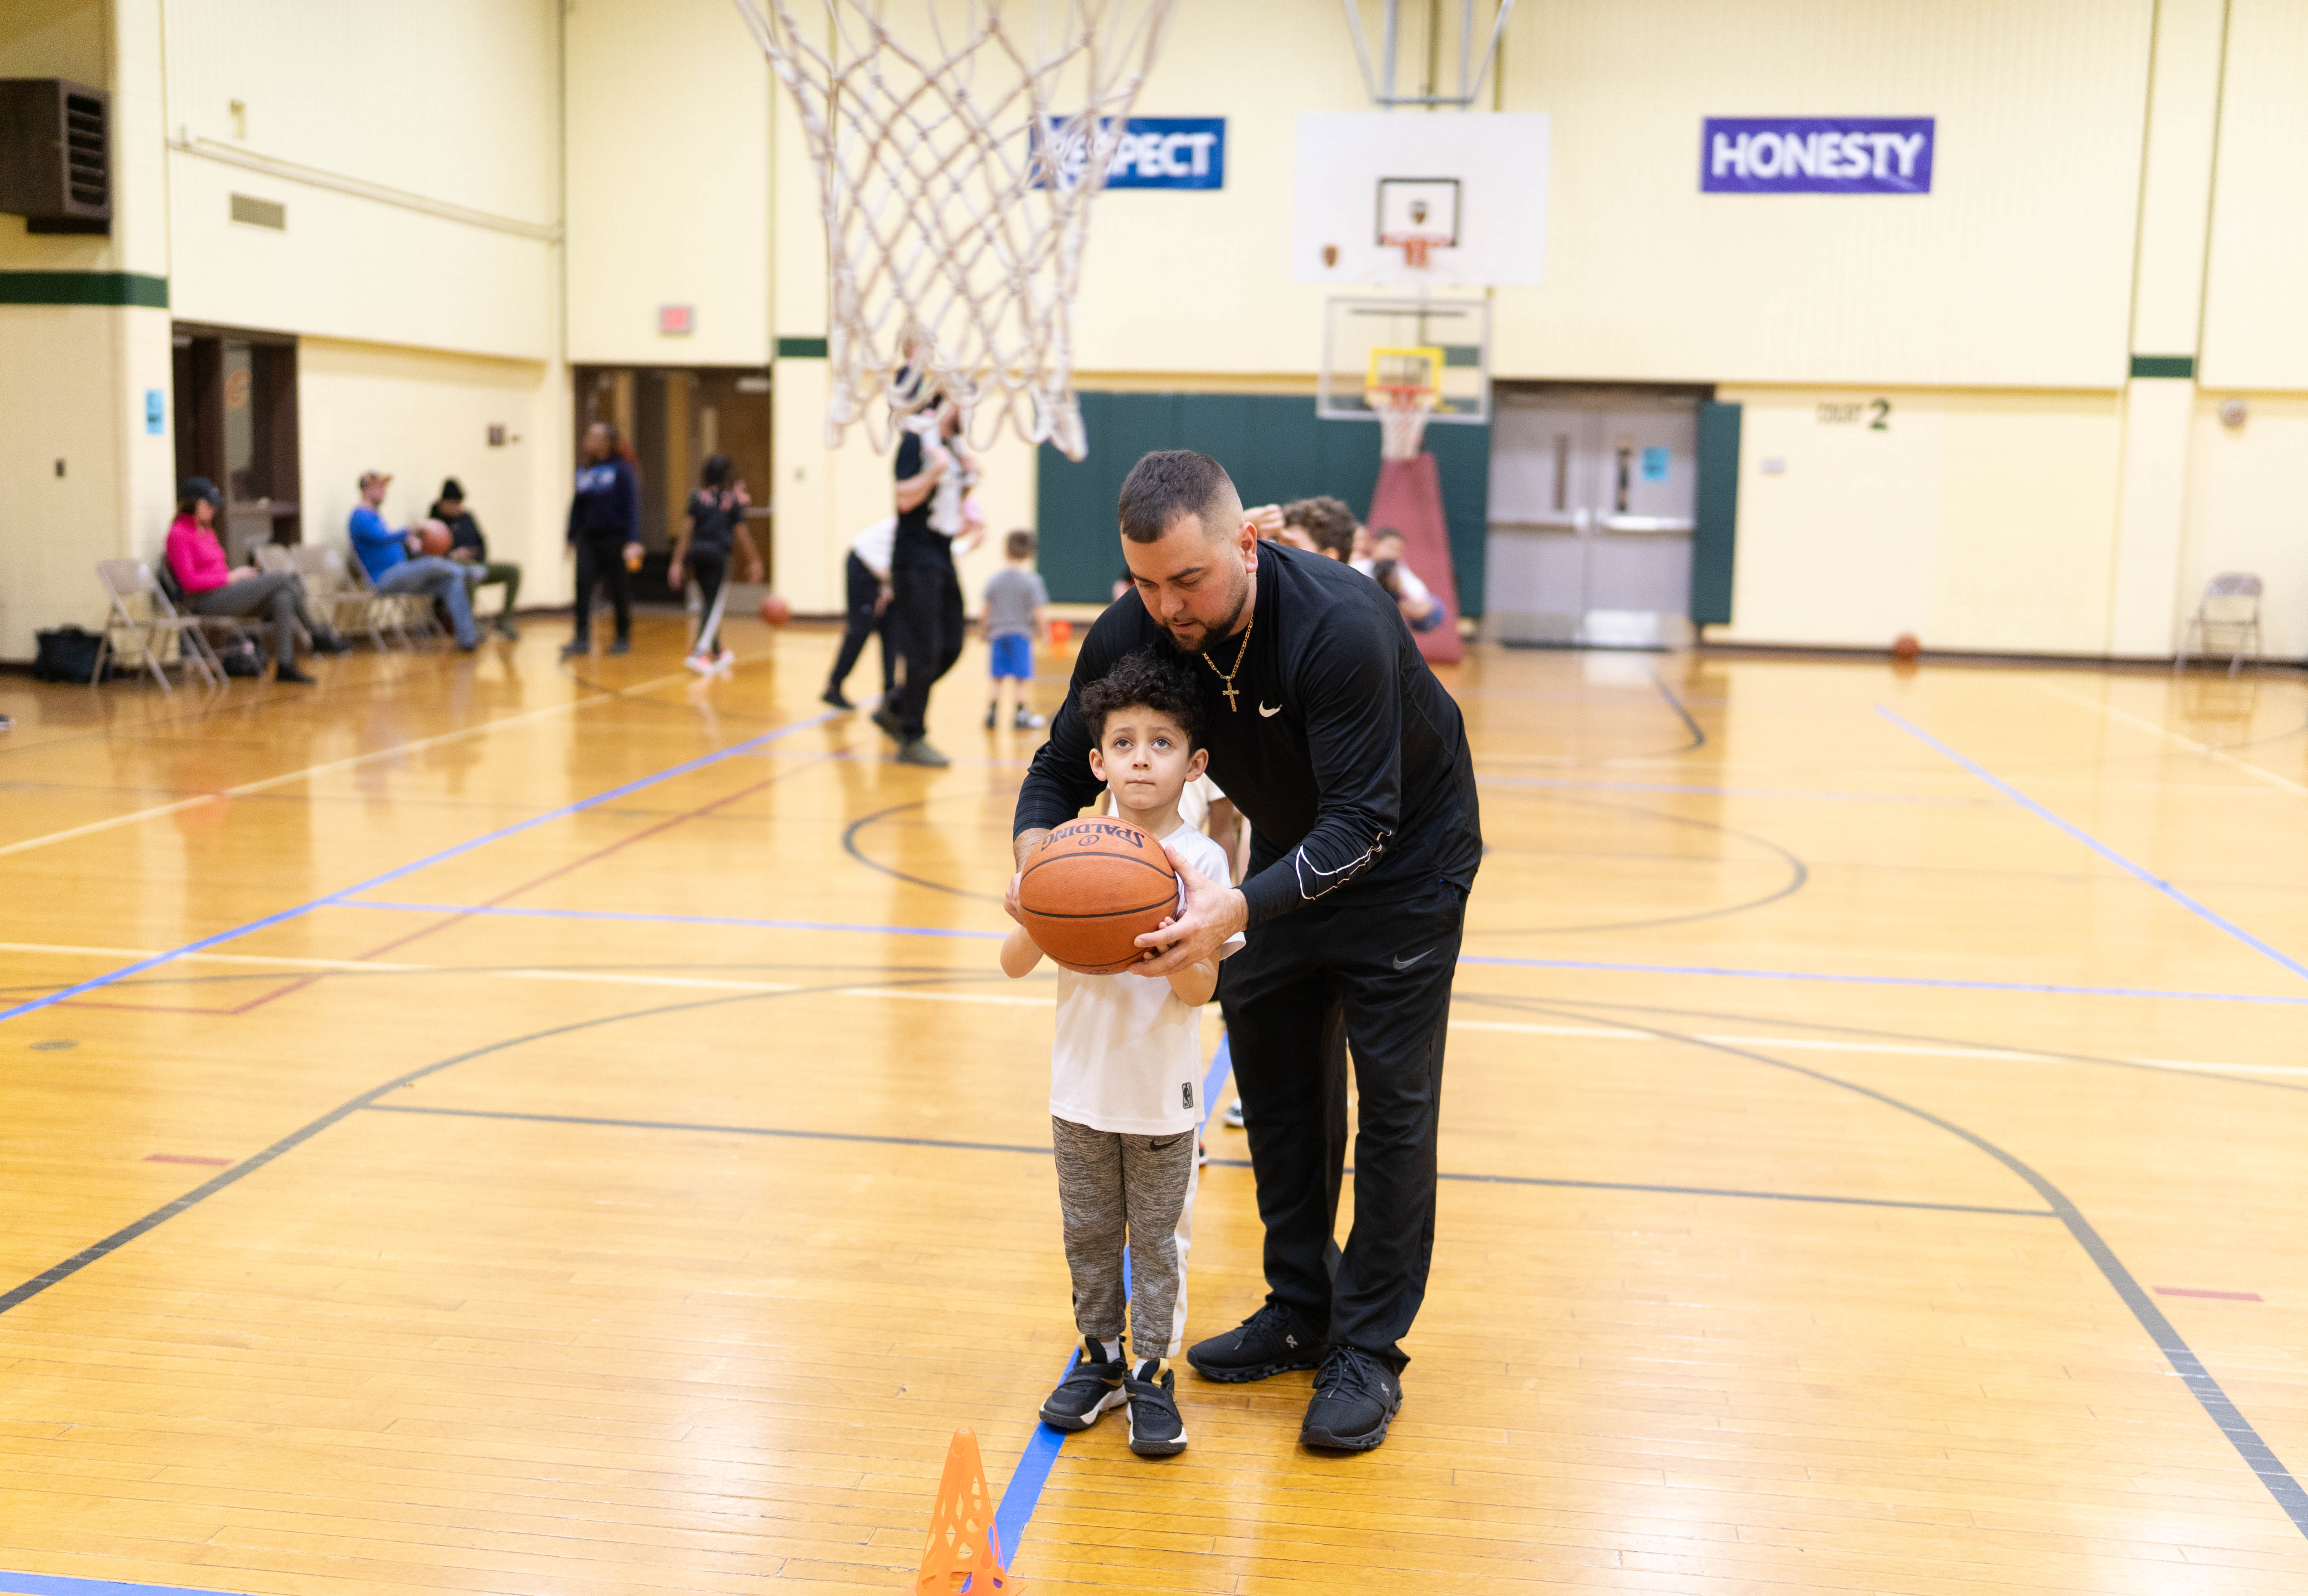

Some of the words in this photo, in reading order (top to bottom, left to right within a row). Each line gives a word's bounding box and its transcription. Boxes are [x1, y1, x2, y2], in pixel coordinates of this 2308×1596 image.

[1044, 131, 1217, 178] EPECT
[1711, 132, 1924, 178] HONESTY
[1869, 398, 1891, 430] 2
[1040, 823, 1145, 852] SPALDING
